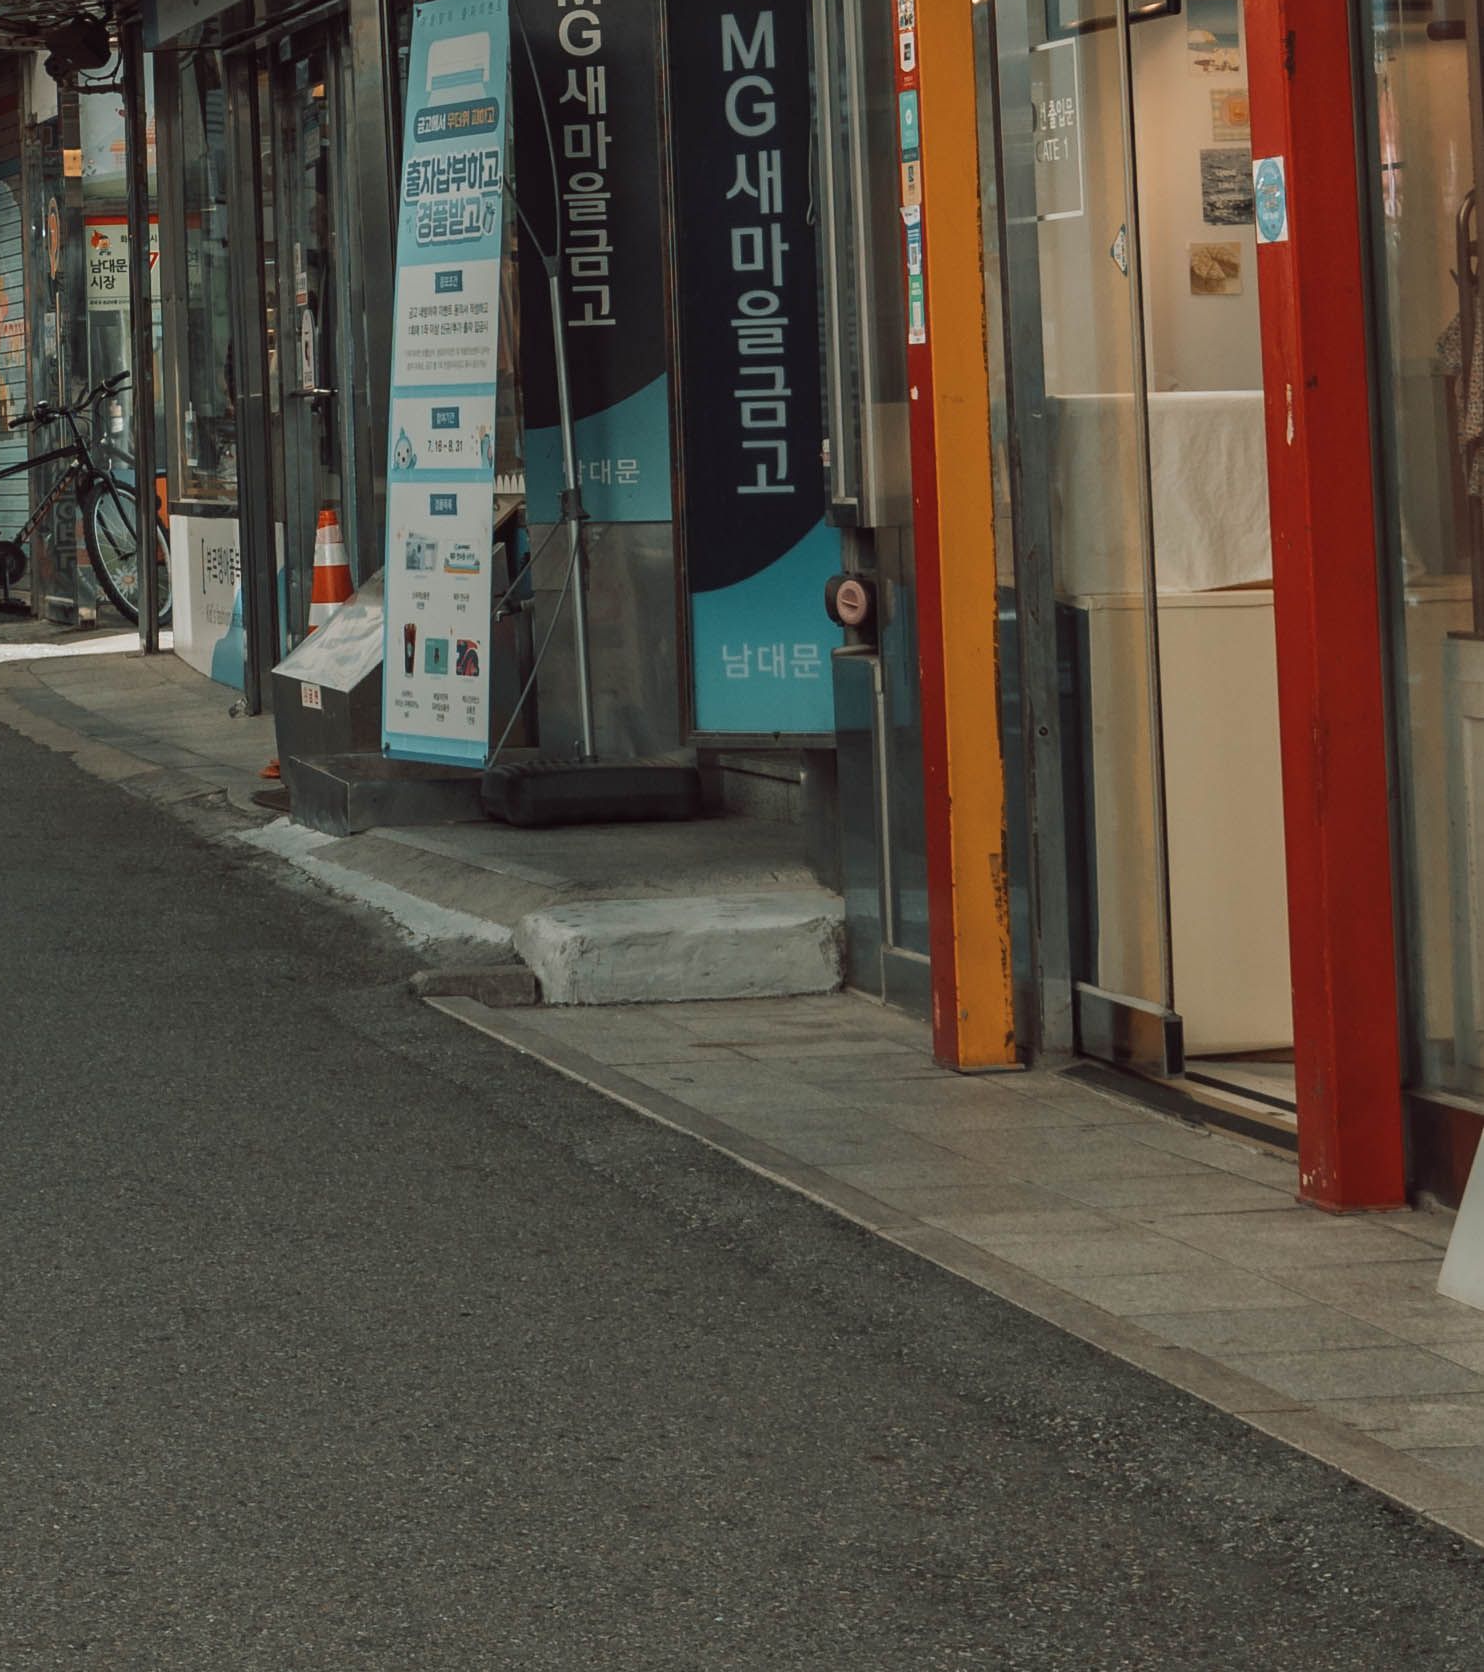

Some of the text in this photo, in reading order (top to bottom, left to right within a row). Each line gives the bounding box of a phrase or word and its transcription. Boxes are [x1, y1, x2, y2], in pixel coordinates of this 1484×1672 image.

[719, 10, 796, 494] MG새마을금고
[89, 258, 128, 274] 남대문
[90, 275, 115, 290] 시장
[722, 642, 822, 679] 남대문
